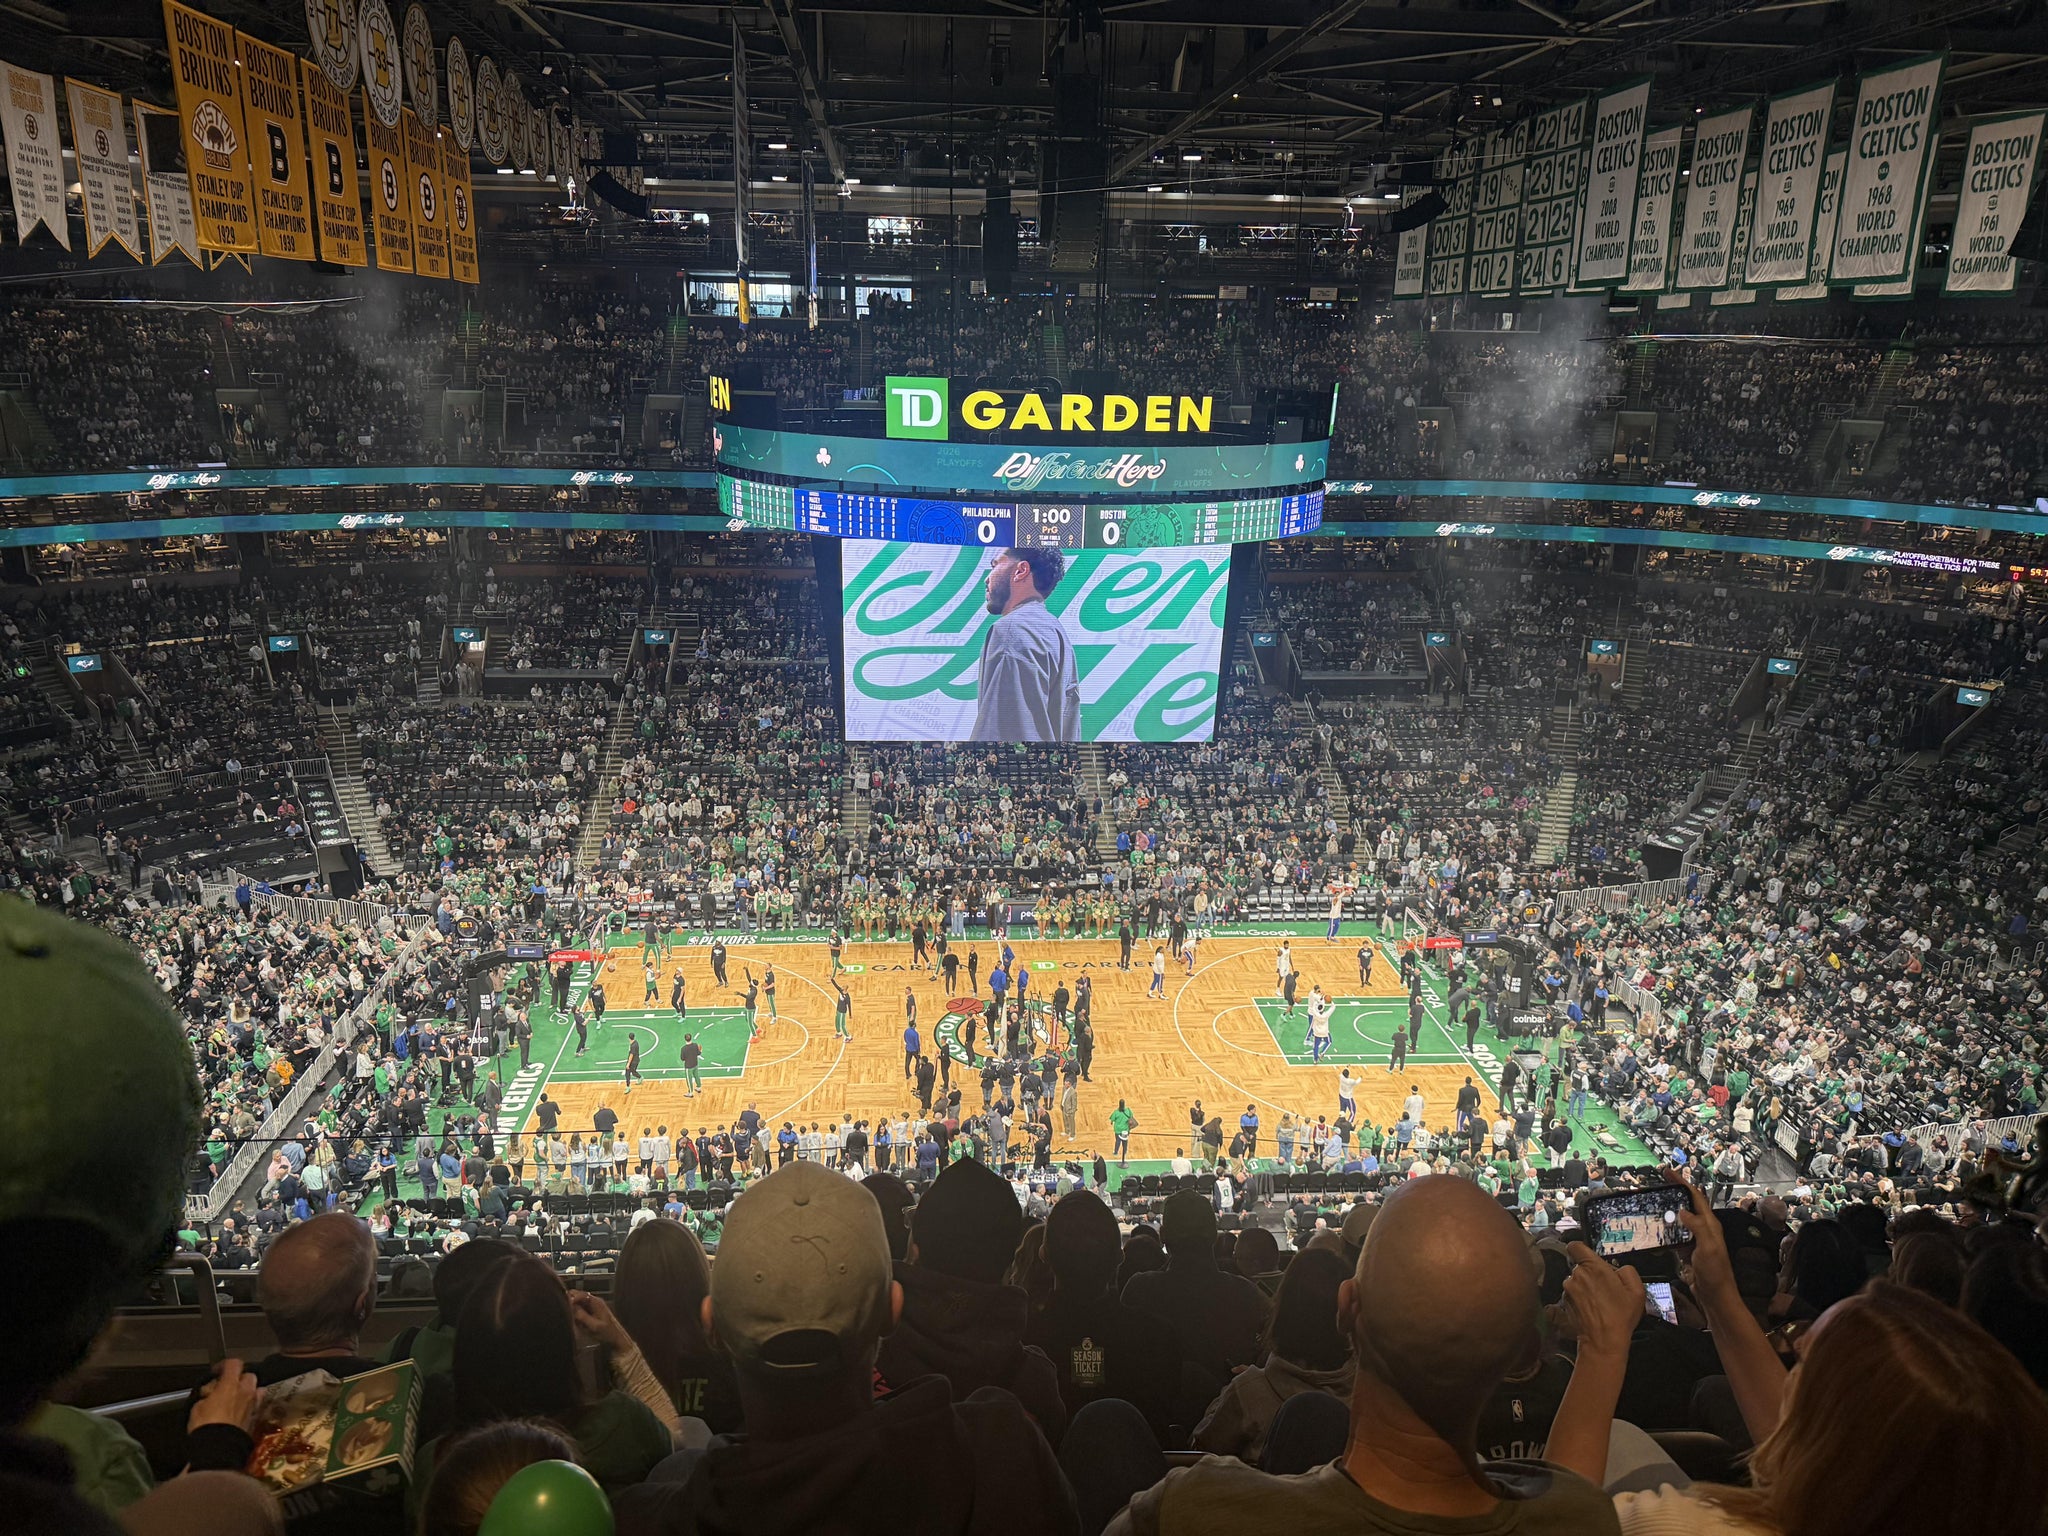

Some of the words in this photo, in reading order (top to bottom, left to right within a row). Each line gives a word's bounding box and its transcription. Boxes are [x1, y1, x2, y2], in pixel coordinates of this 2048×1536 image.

[173, 8, 229, 61] BOSTON
[244, 40, 291, 87] BOSTON
[375, 47, 387, 72] 33
[178, 46, 233, 98] BRUINS
[249, 74, 294, 120] BRUINS
[1860, 85, 1930, 128] BOSTON
[312, 101, 348, 138] BRUINS
[1536, 116, 1557, 150] 22
[1563, 107, 1582, 143] 14
[1598, 103, 1643, 144] BOSTON
[1770, 109, 1824, 147] BOSTON
[371, 124, 400, 157] BRUINS
[1697, 129, 1744, 162] BOSTON
[1859, 120, 1921, 159] CELTICS
[1972, 135, 2035, 167] BOSTON
[17, 153, 54, 169] CHAMPIONS
[205, 152, 231, 169] BRUINS
[266, 119, 290, 186] B
[409, 140, 437, 171] BRUINS
[1596, 139, 1637, 175] CELTICS
[1768, 140, 1817, 175] CELTICS
[446, 154, 468, 182] BRUINS
[1531, 160, 1552, 195] 23
[1557, 154, 1578, 190] 15
[1695, 158, 1738, 189] CELTICS
[1971, 163, 2026, 193] CELTICS
[196, 173, 229, 198] STANLEY
[230, 180, 244, 201] CUP
[1455, 181, 1472, 217] 35
[1483, 175, 1498, 207] 19
[1868, 184, 1893, 207] 1968
[199, 197, 248, 224] CHAMPIONS
[261, 188, 290, 213] STANLEY
[291, 196, 303, 213] CUP
[322, 201, 345, 222] STANLEY
[345, 206, 356, 222] CUP
[1600, 198, 1618, 217] 2008
[1775, 197, 1795, 218] 1969
[263, 210, 307, 234] CHAMPIONS
[323, 220, 360, 242] CHAMPIONS
[418, 224, 435, 241] STANLEY
[435, 229, 443, 242] CUP
[1477, 216, 1494, 248] 17
[1499, 212, 1516, 246] 18
[1527, 206, 1546, 241] 21
[1550, 202, 1572, 237] 25
[1595, 220, 1620, 239] WORLD
[1640, 219, 1656, 236] 1976
[1766, 219, 1798, 242] WORLD
[1856, 209, 1896, 233] WORLD
[1979, 215, 2000, 233] 1961
[217, 224, 236, 245] 1929
[279, 235, 296, 252] 1939
[381, 231, 409, 251] CHAMPIONS
[1434, 225, 1449, 254] 00
[1453, 221, 1468, 251] 31
[1633, 237, 1659, 256] WORLD
[1693, 233, 1721, 250] WORLD
[1839, 233, 1903, 258] CHAMPIONS
[1969, 235, 2005, 254] WORLD
[419, 241, 445, 258] CHAMPIONS
[1584, 241, 1625, 263] CHAMPIONS
[1681, 251, 1727, 270] CHAMPIONS
[1752, 241, 1804, 264] CHAMPIONS
[1398, 267, 1422, 281] CHAMPIONS
[1473, 257, 1489, 288] 10
[1496, 255, 1509, 287] 2
[1522, 250, 1543, 284] 24
[1551, 248, 1563, 281] 6
[1952, 255, 2012, 274] CHAMPIONS
[1431, 263, 1444, 293] 34
[1451, 262, 1459, 289] 5
[891, 388, 943, 427] TD
[961, 390, 1213, 432] GARDEN
[936, 457, 984, 468] PLAYOFFS
[992, 452, 1112, 491] Different
[1109, 453, 1167, 488] Here
[962, 507, 1012, 519] PHILADELPHIA
[1033, 508, 1071, 524] 1:00
[1100, 510, 1127, 520] BOSTON
[977, 520, 996, 544] 0
[1042, 526, 1058, 534] PrG
[1102, 522, 1120, 545] 0
[1929, 562, 1961, 572] CELTICS
[1962, 565, 1971, 573] IN
[1963, 558, 1977, 566] FOR
[1978, 560, 2000, 569] THESE
[2013, 572, 2019, 580] 0
[700, 935, 758, 945] PLAYOFFS
[1247, 929, 1298, 937] Google
[1033, 960, 1055, 970] TD
[500, 1062, 546, 1112] CELTICS
[1073, 1351, 1102, 1361] SEASON
[1073, 1361, 1102, 1373] TICKET
